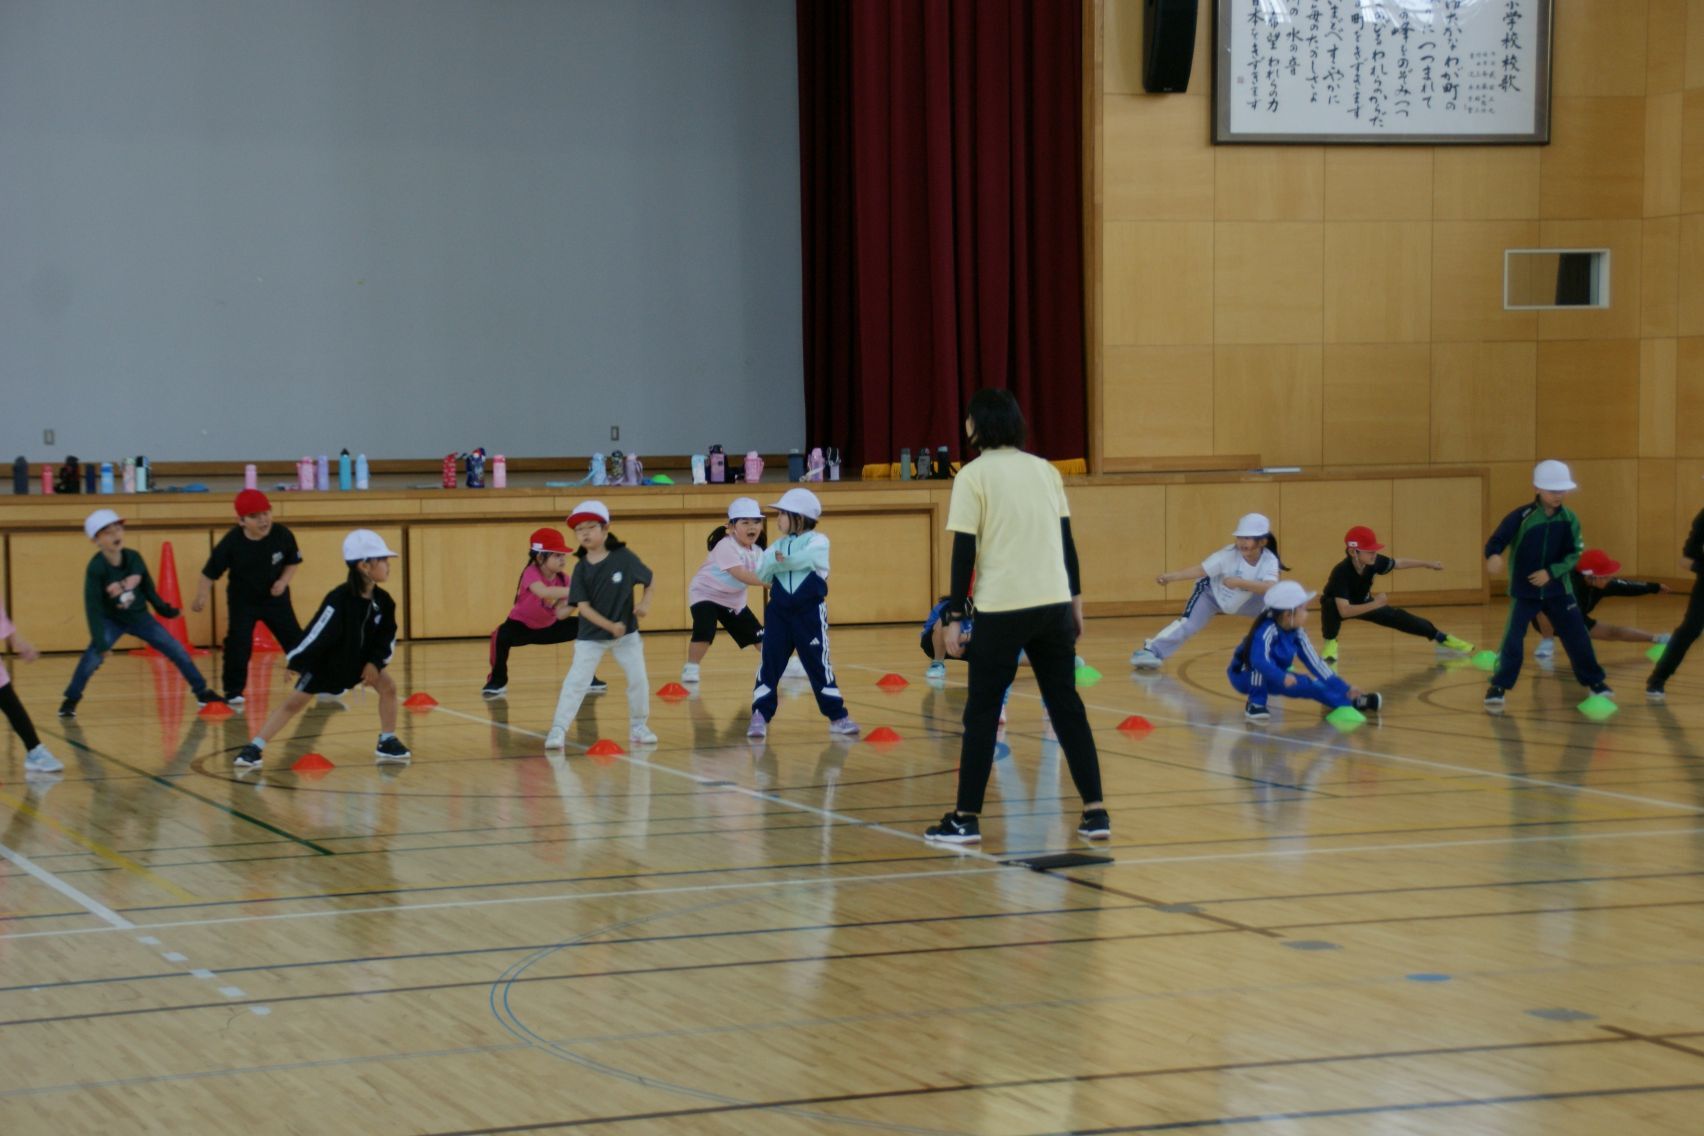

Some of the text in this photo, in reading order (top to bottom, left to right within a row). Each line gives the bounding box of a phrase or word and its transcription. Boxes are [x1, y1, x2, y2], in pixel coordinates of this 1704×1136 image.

[1418, 9, 1437, 109] につつまれて
